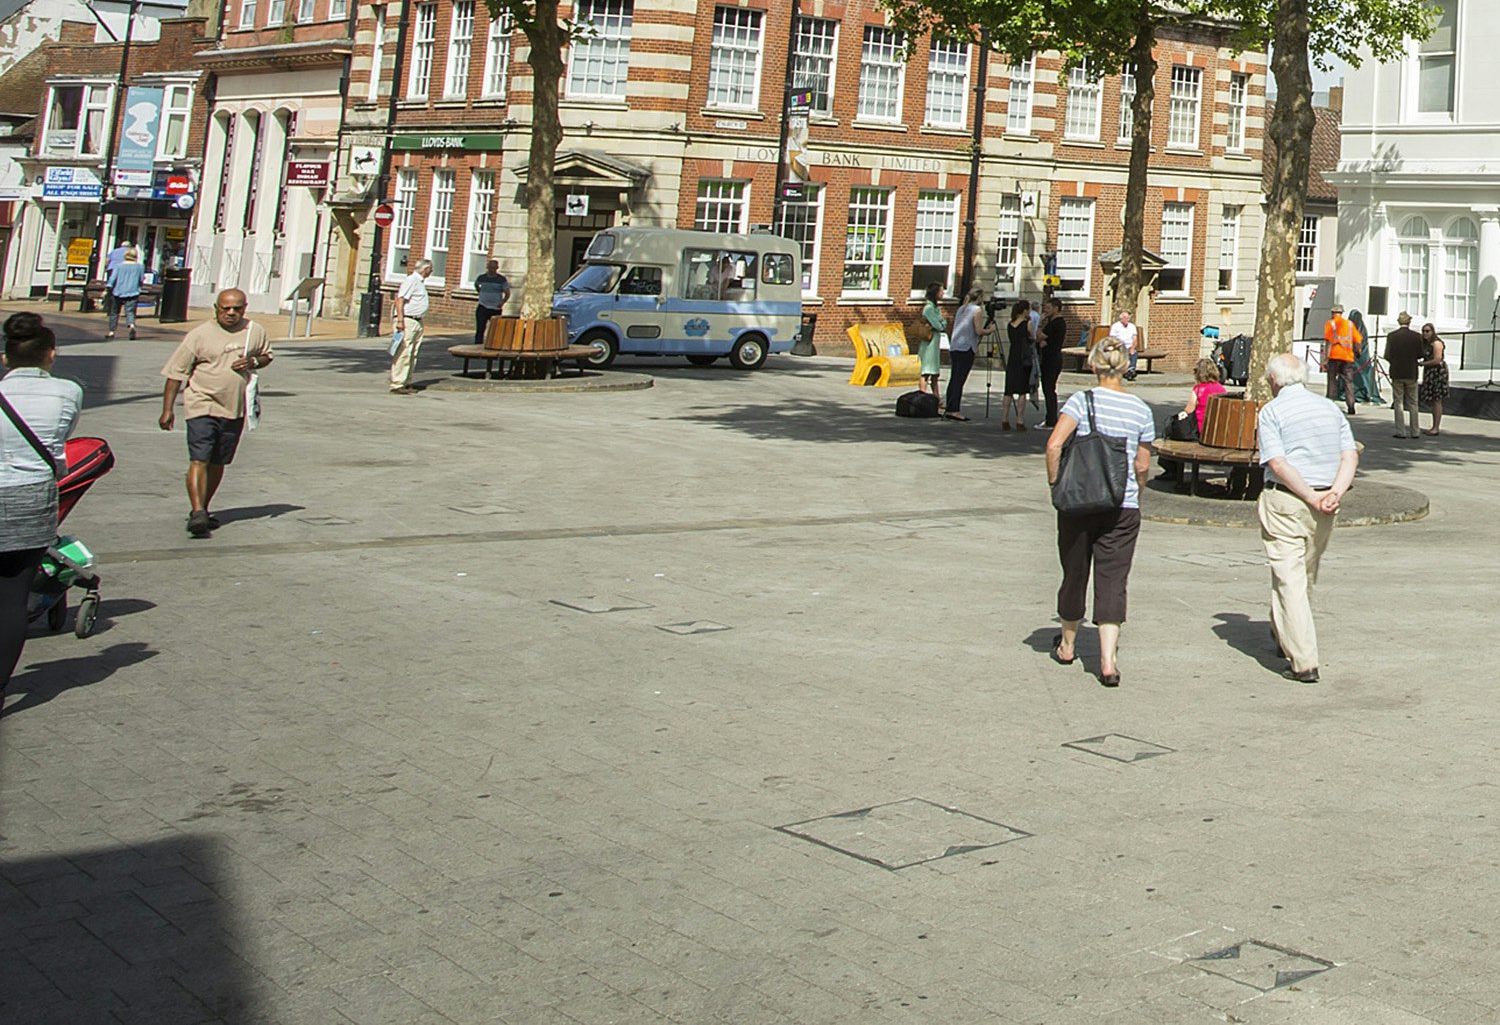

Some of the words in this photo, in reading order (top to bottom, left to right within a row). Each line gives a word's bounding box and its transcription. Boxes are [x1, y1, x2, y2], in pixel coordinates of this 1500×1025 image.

[421, 137, 446, 148] LLOYDS
[446, 137, 464, 148] BANK
[736, 146, 778, 162] LLOY
[822, 152, 861, 166] BANK
[881, 156, 942, 171] LIMITED
